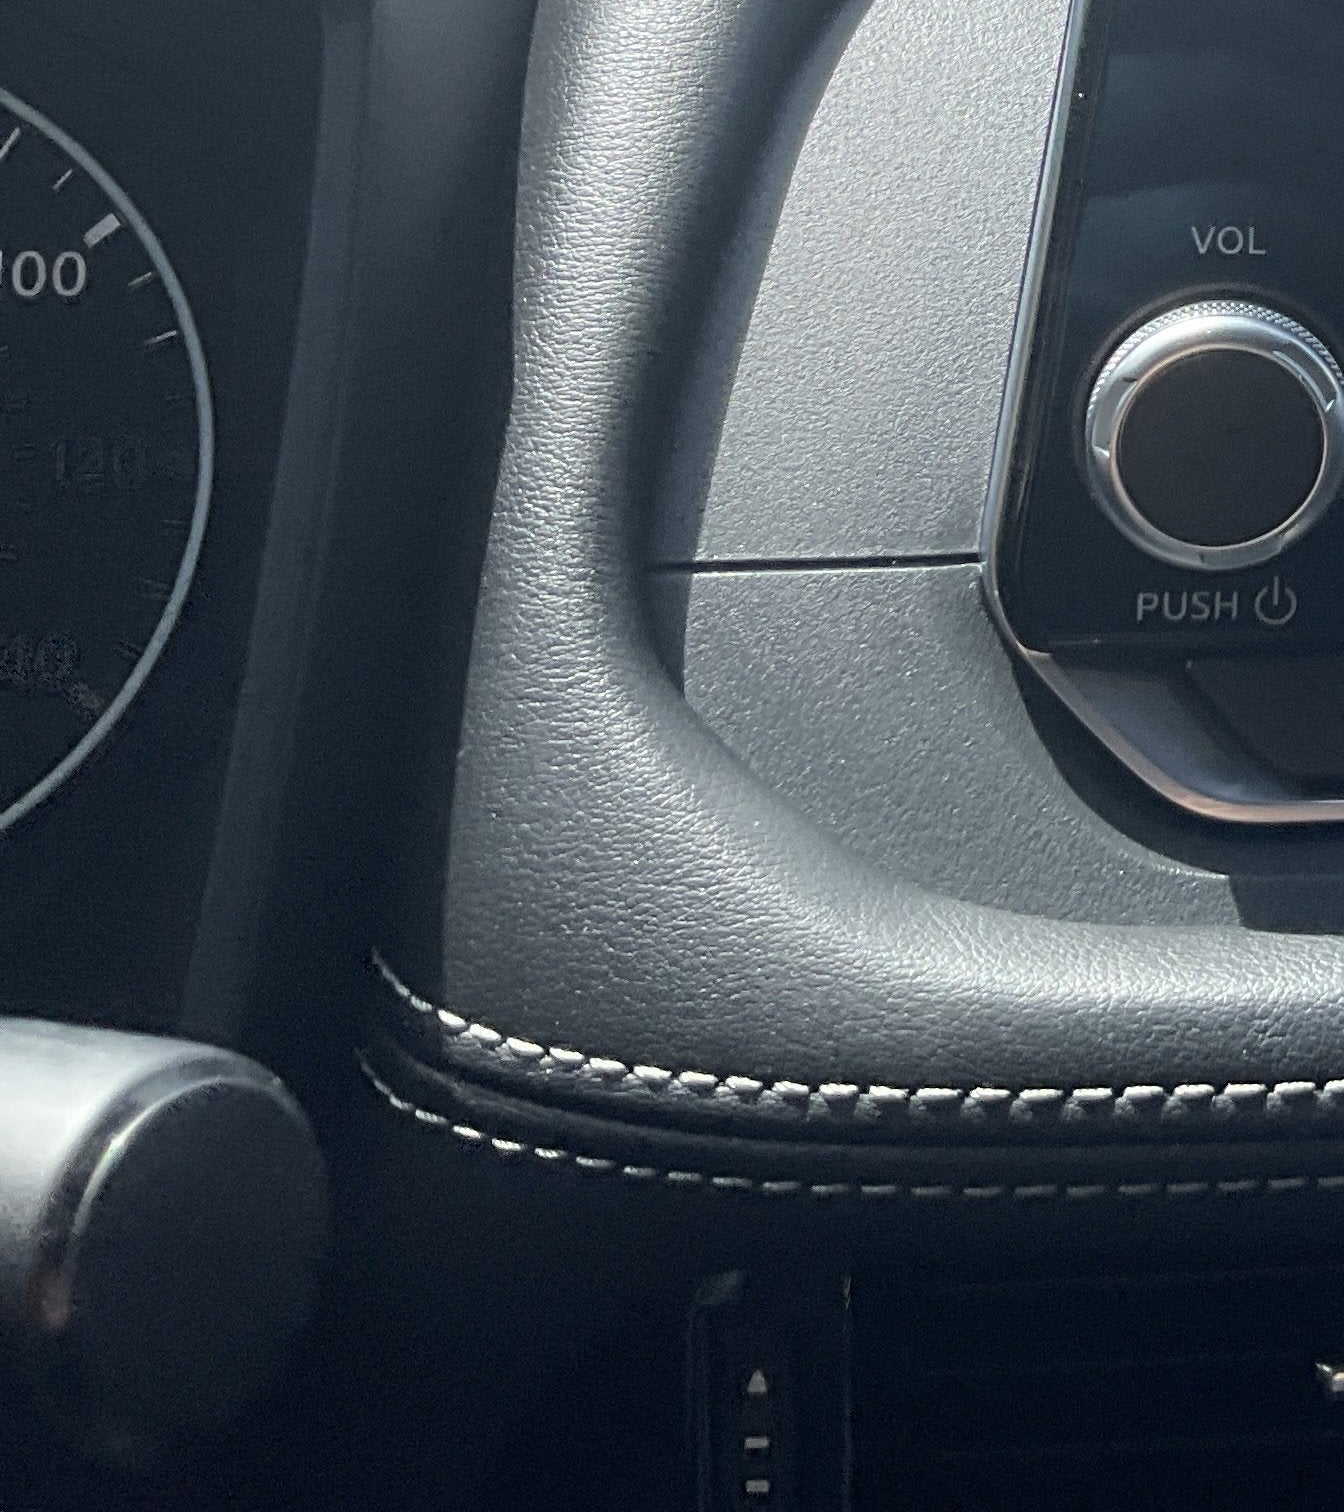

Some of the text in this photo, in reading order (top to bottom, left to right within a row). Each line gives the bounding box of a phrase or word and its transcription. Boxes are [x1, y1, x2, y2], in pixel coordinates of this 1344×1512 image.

[1191, 226, 1267, 255] VOL
[0, 250, 87, 297] 00
[1136, 591, 1239, 622] PUSH
